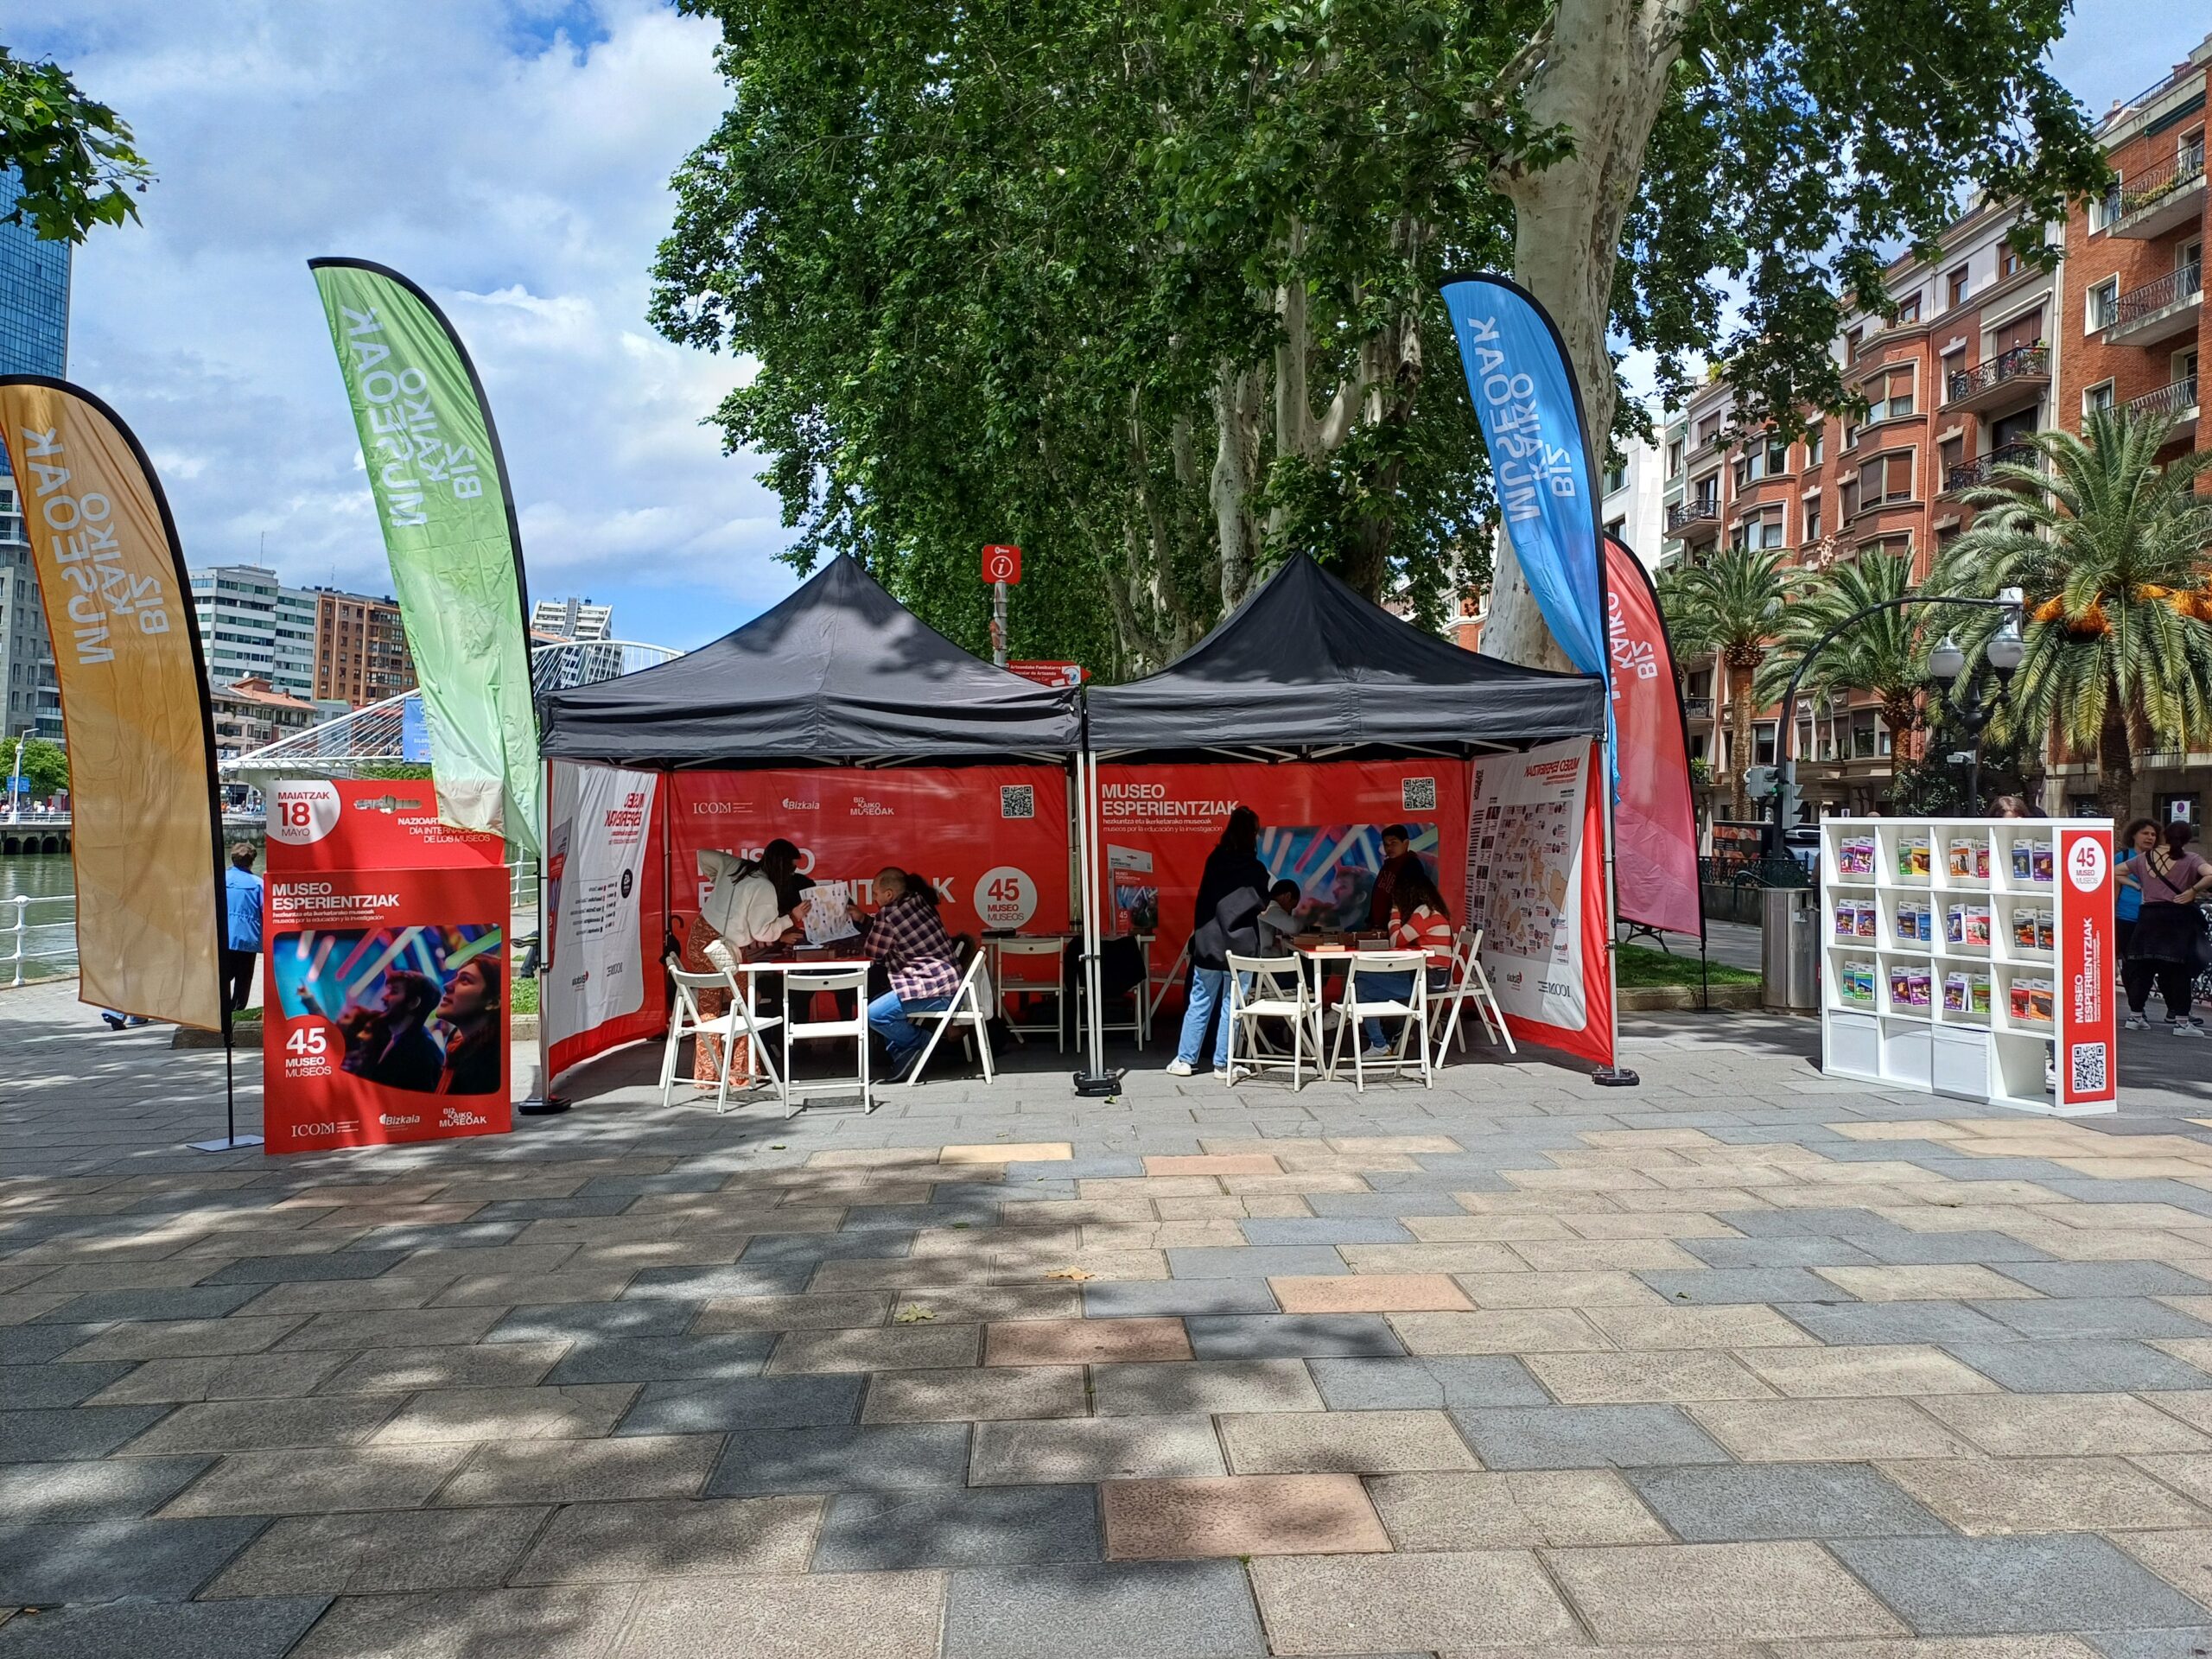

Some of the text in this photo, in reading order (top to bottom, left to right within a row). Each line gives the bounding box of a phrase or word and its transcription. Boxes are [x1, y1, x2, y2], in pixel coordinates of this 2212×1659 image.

[1102, 784, 1165, 798] MUSEO
[693, 802, 731, 814] ICOM
[788, 800, 819, 810] Bizkaia
[1102, 800, 1239, 816] ESPERIENTZIAK
[277, 802, 311, 826] 18
[282, 828, 310, 836] MAYO
[410, 826, 423, 835] DÍA
[454, 834, 491, 842] MUSEOS
[2076, 848, 2095, 867] 45
[272, 882, 332, 896] MUSEO
[988, 878, 1020, 901] 45
[272, 894, 400, 911] ESPERIENTZIAK
[988, 912, 1024, 921] MUSEOS
[2083, 917, 2093, 1023] ESPERIENTZIAK
[2075, 974, 2084, 1023] MUSEO
[286, 1027, 327, 1054] 45
[285, 1057, 325, 1067] MUSEO
[285, 1065, 332, 1077] MUSEOS
[386, 1114, 420, 1125] Bizkaia
[439, 1116, 487, 1128] MUSEOAK
[291, 1122, 334, 1137] ICOM
